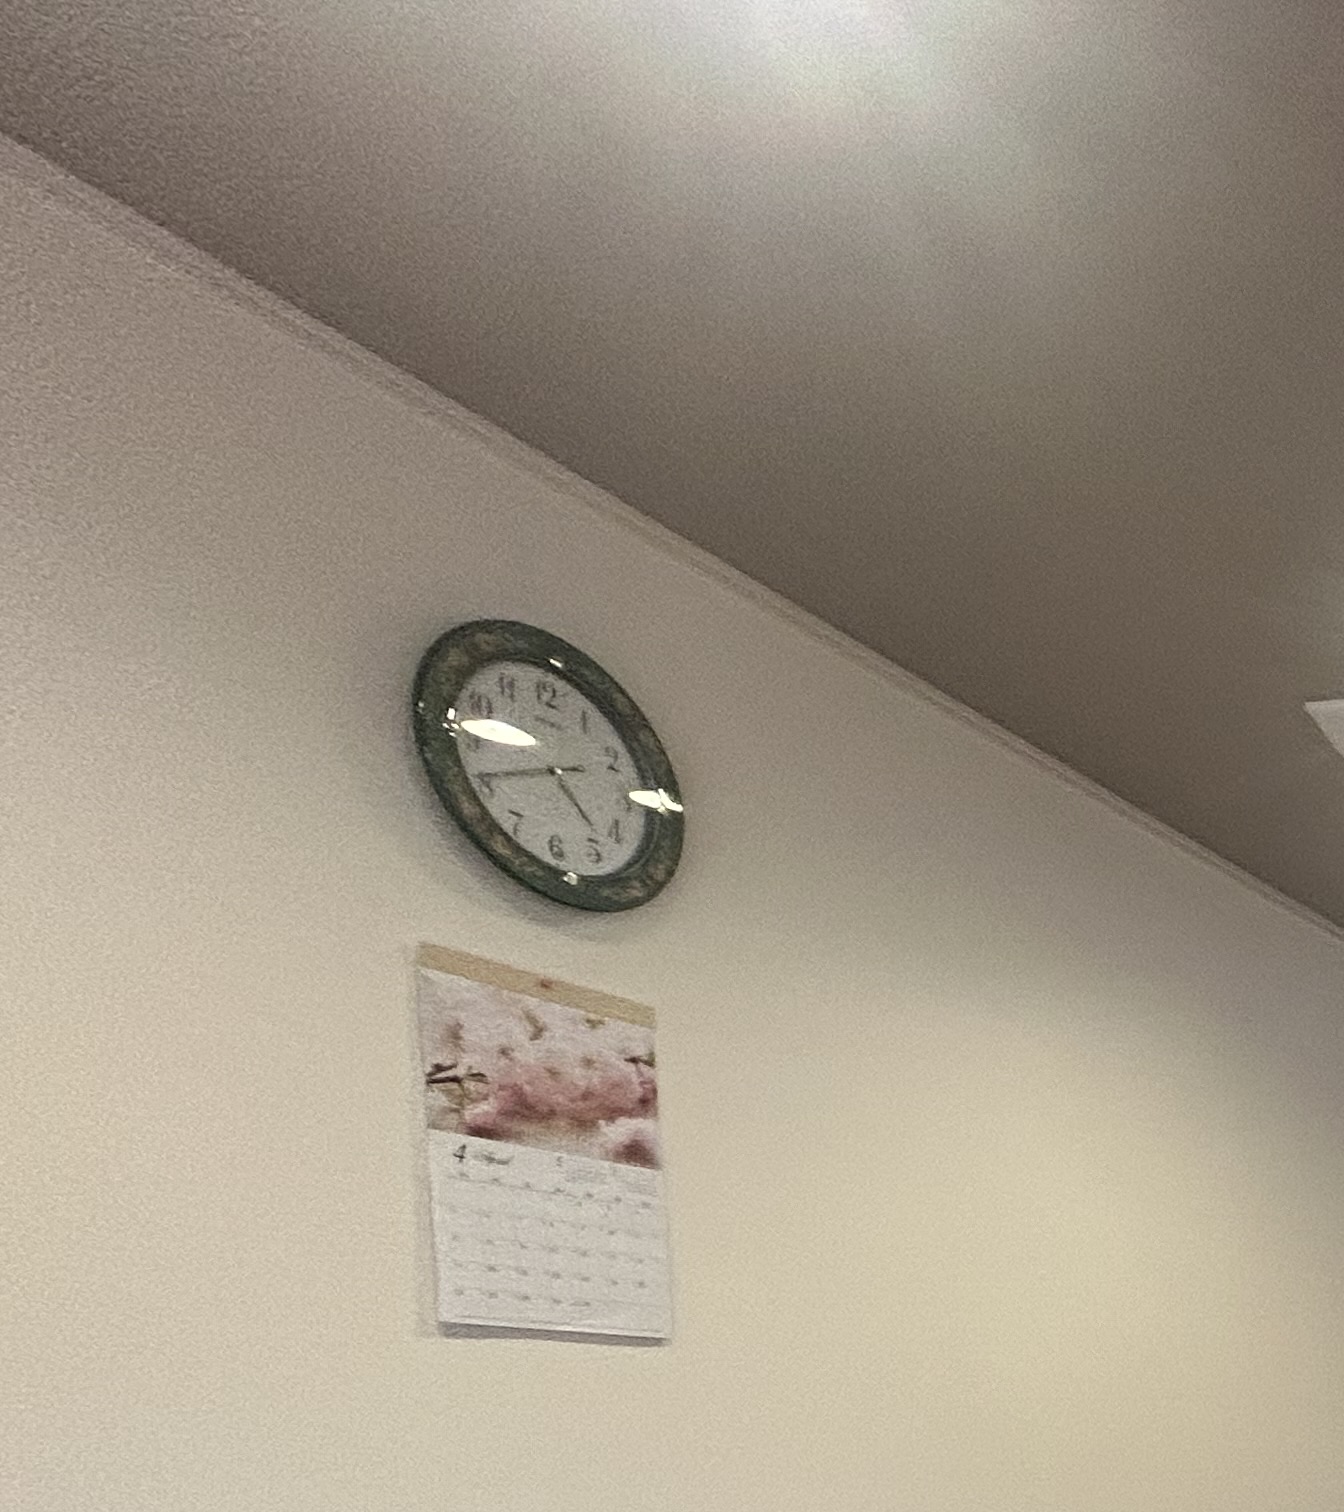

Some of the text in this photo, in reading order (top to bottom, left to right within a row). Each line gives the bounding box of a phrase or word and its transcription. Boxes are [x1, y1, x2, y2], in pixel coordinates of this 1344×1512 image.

[535, 679, 560, 710] 12
[603, 746, 621, 773] 2
[508, 809, 525, 837] 7
[607, 819, 622, 845] 4
[548, 834, 565, 861] 6
[586, 837, 603, 864] 5
